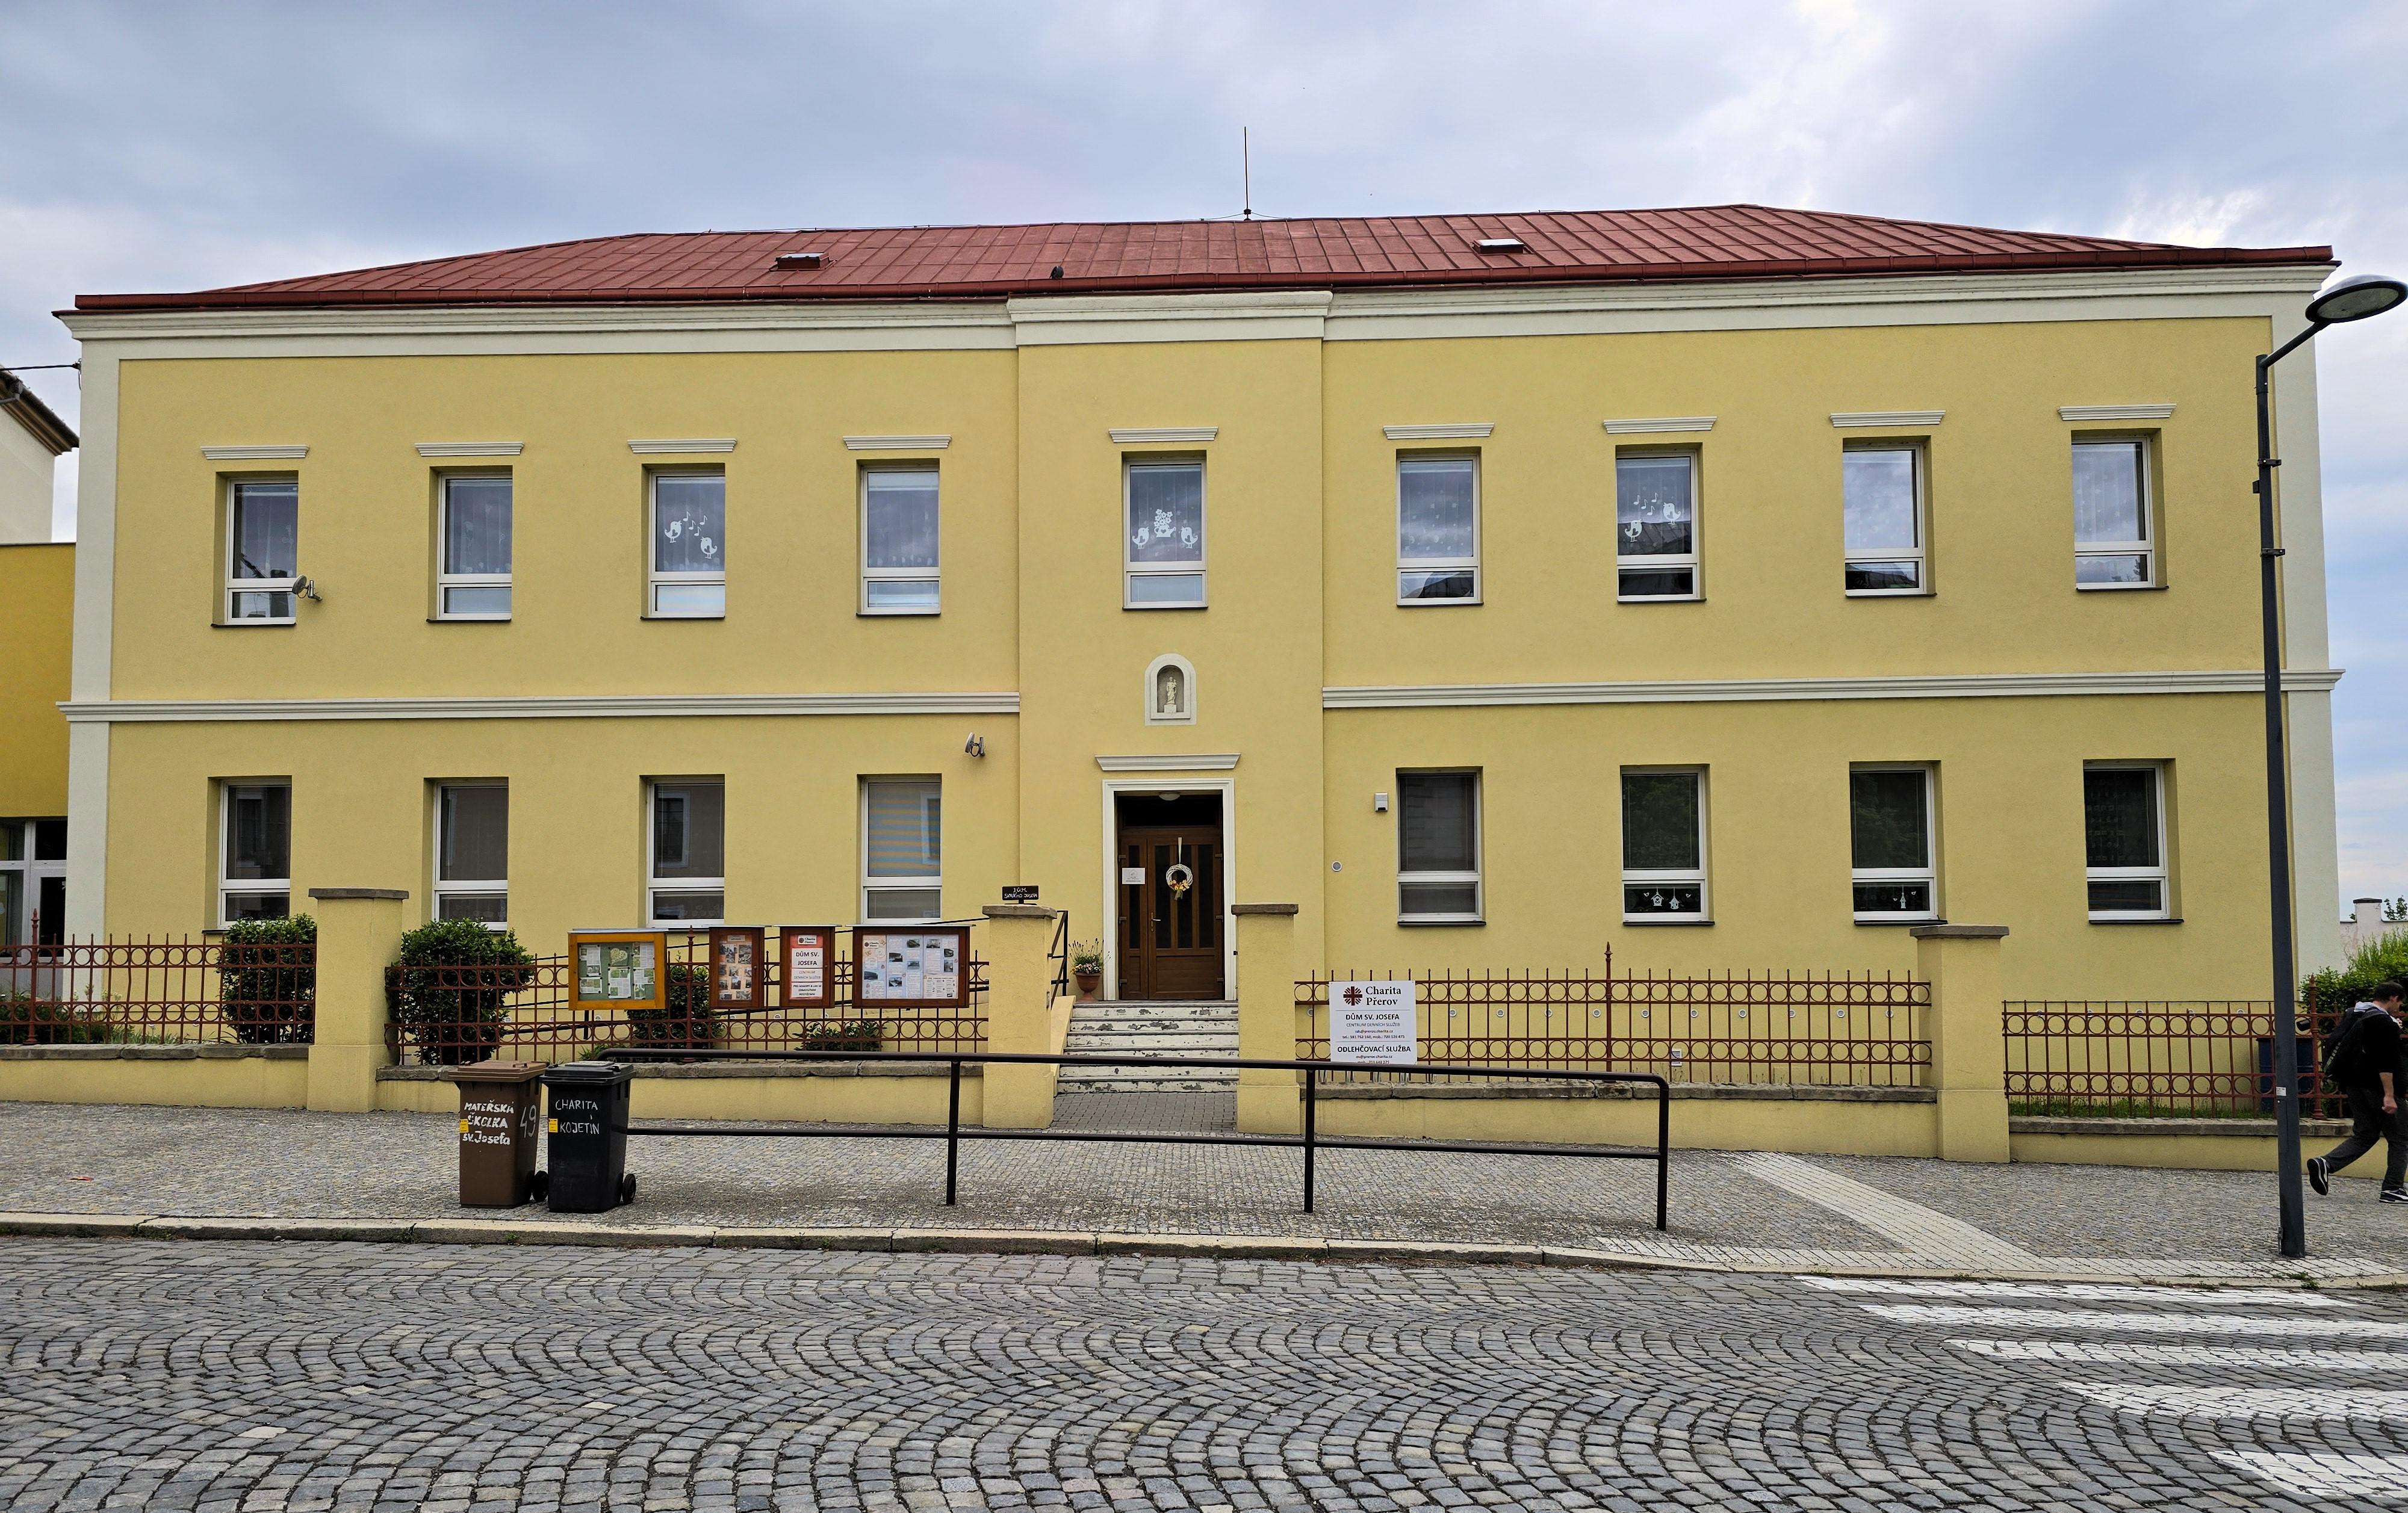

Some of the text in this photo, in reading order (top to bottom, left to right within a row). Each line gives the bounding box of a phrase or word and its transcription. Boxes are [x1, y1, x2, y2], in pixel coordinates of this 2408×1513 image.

[1365, 986, 1401, 995] Charita
[1366, 997, 1398, 1006] Přerov
[464, 1099, 514, 1113] MATEŘSKÁ
[555, 1099, 598, 1110] CHARITA
[520, 1104, 537, 1139] 49
[560, 1114, 600, 1134] KOJETÍN
